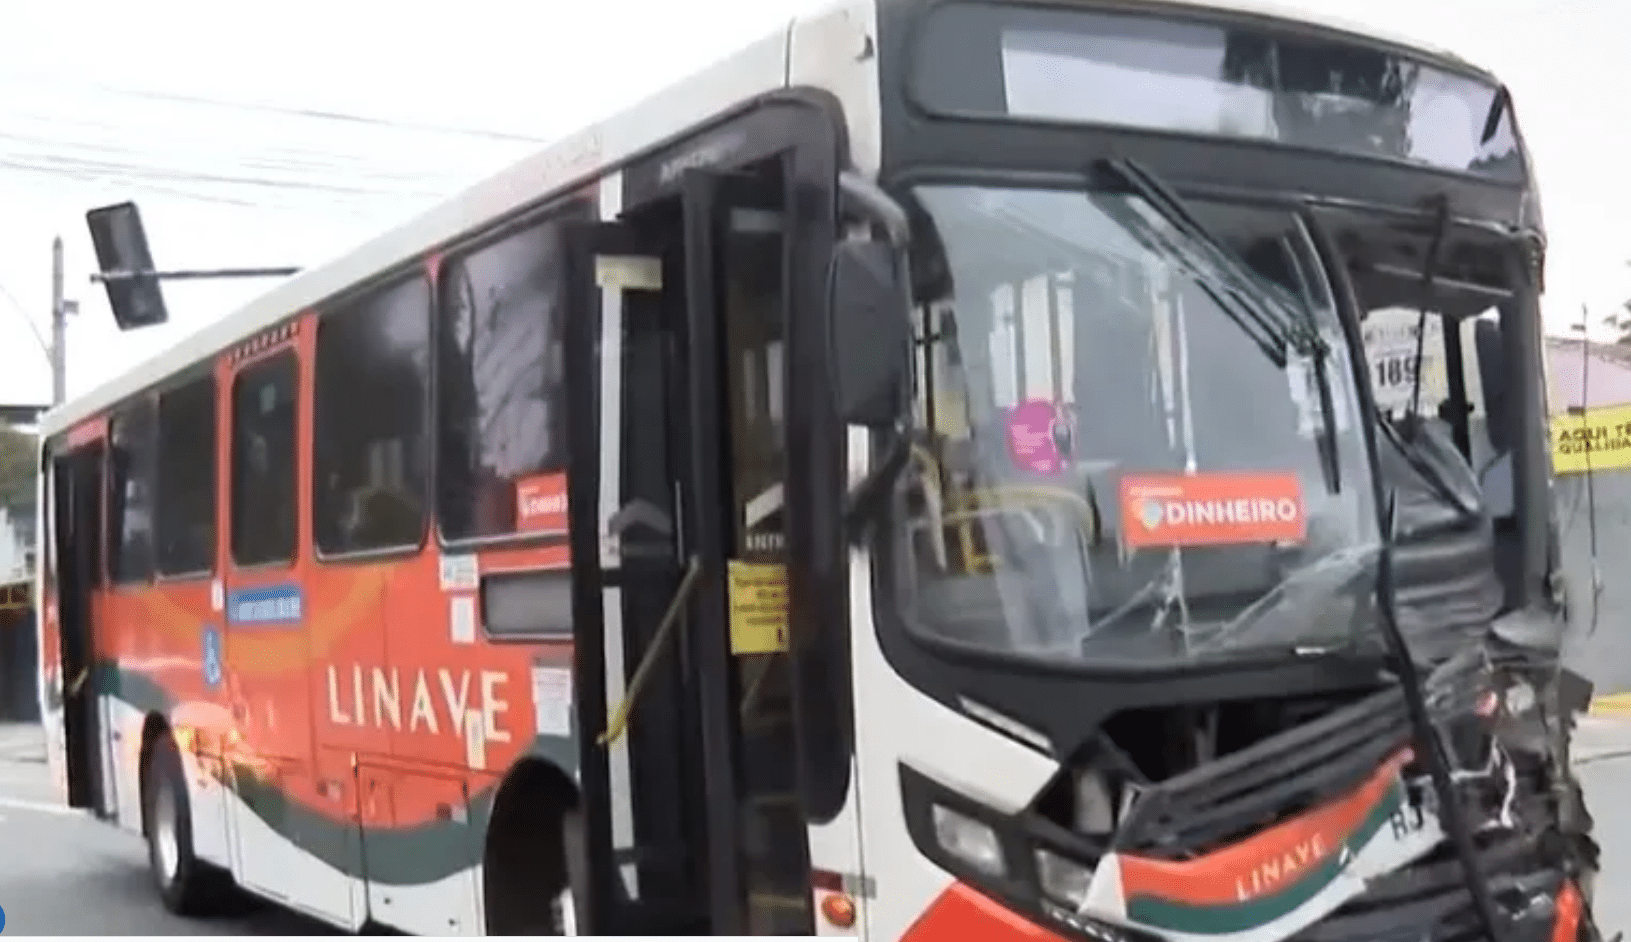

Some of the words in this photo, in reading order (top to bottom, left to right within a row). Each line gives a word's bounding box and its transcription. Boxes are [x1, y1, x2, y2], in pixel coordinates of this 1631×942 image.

[1560, 427, 1608, 441] AQUI
[1167, 498, 1297, 525] DINHEIRO
[327, 663, 512, 743] LINAVE
[1235, 833, 1325, 903] LINAVE
